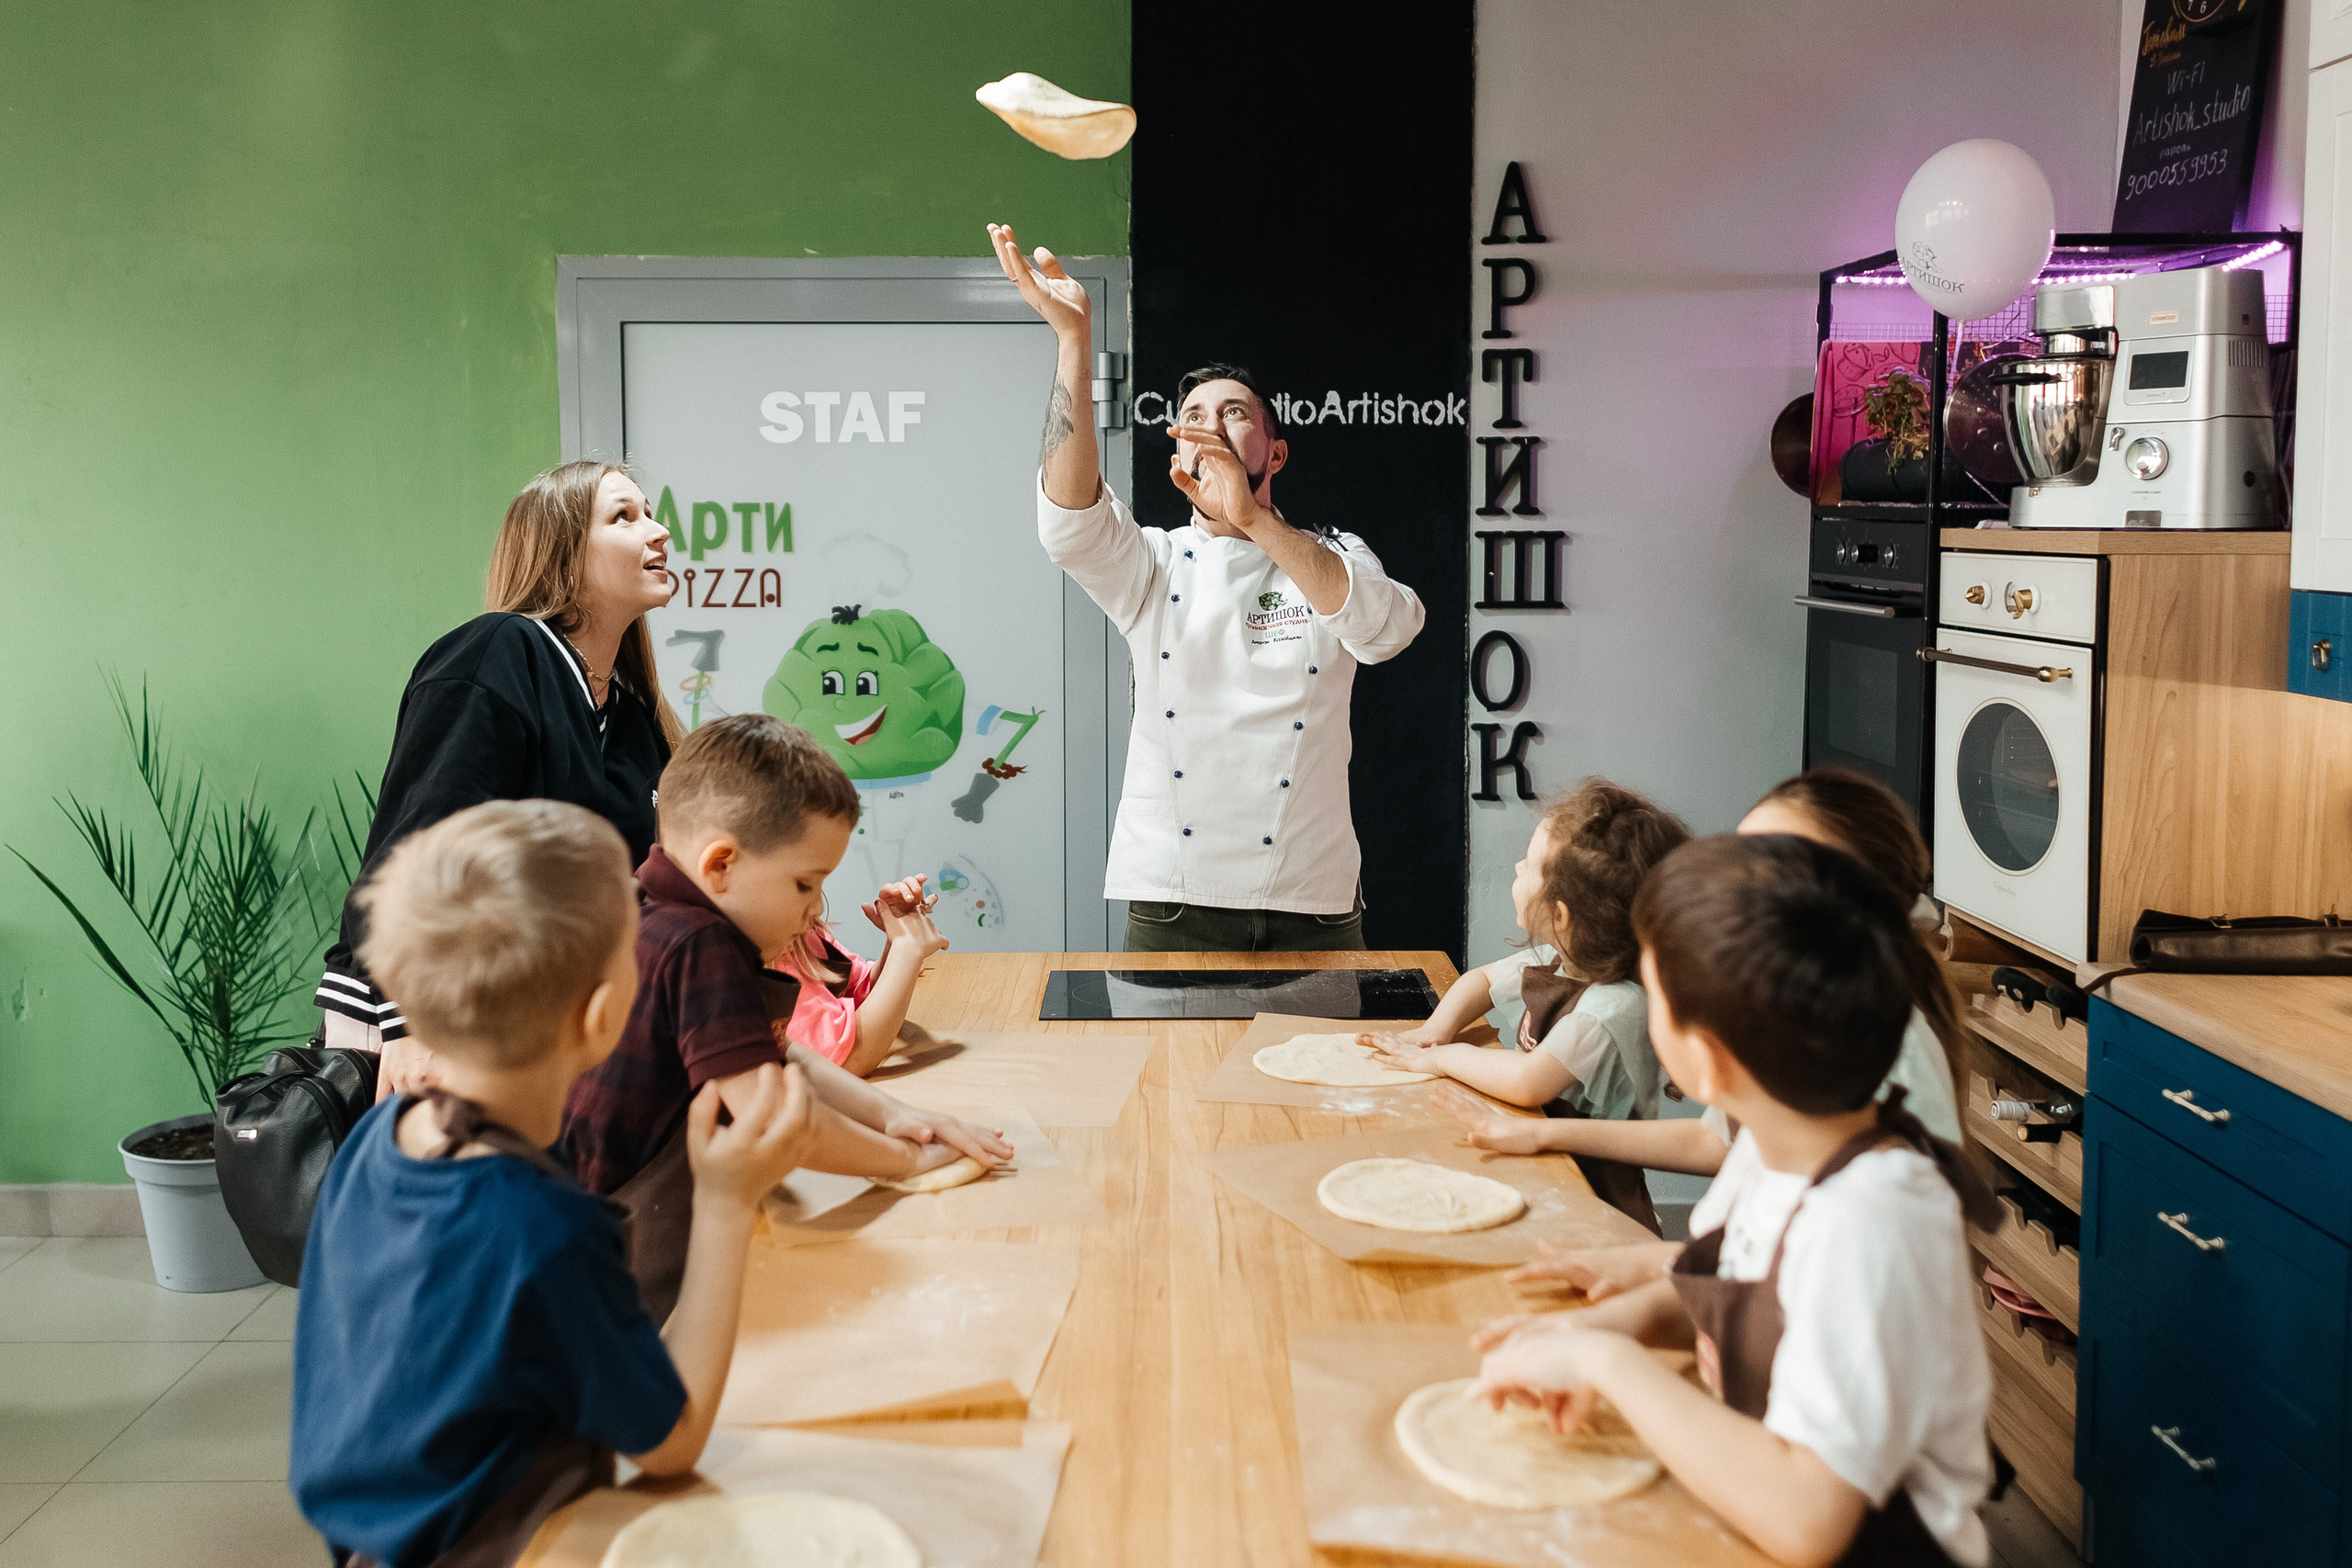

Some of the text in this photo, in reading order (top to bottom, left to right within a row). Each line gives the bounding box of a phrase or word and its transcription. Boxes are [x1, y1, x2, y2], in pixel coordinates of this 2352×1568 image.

[2125, 148, 2228, 200] 9000559953
[758, 390, 926, 444] STAF
[1471, 161, 1566, 801] АРТИШОК
[653, 484, 794, 561] Арти
[1247, 605, 1305, 625] АРТИШОК
